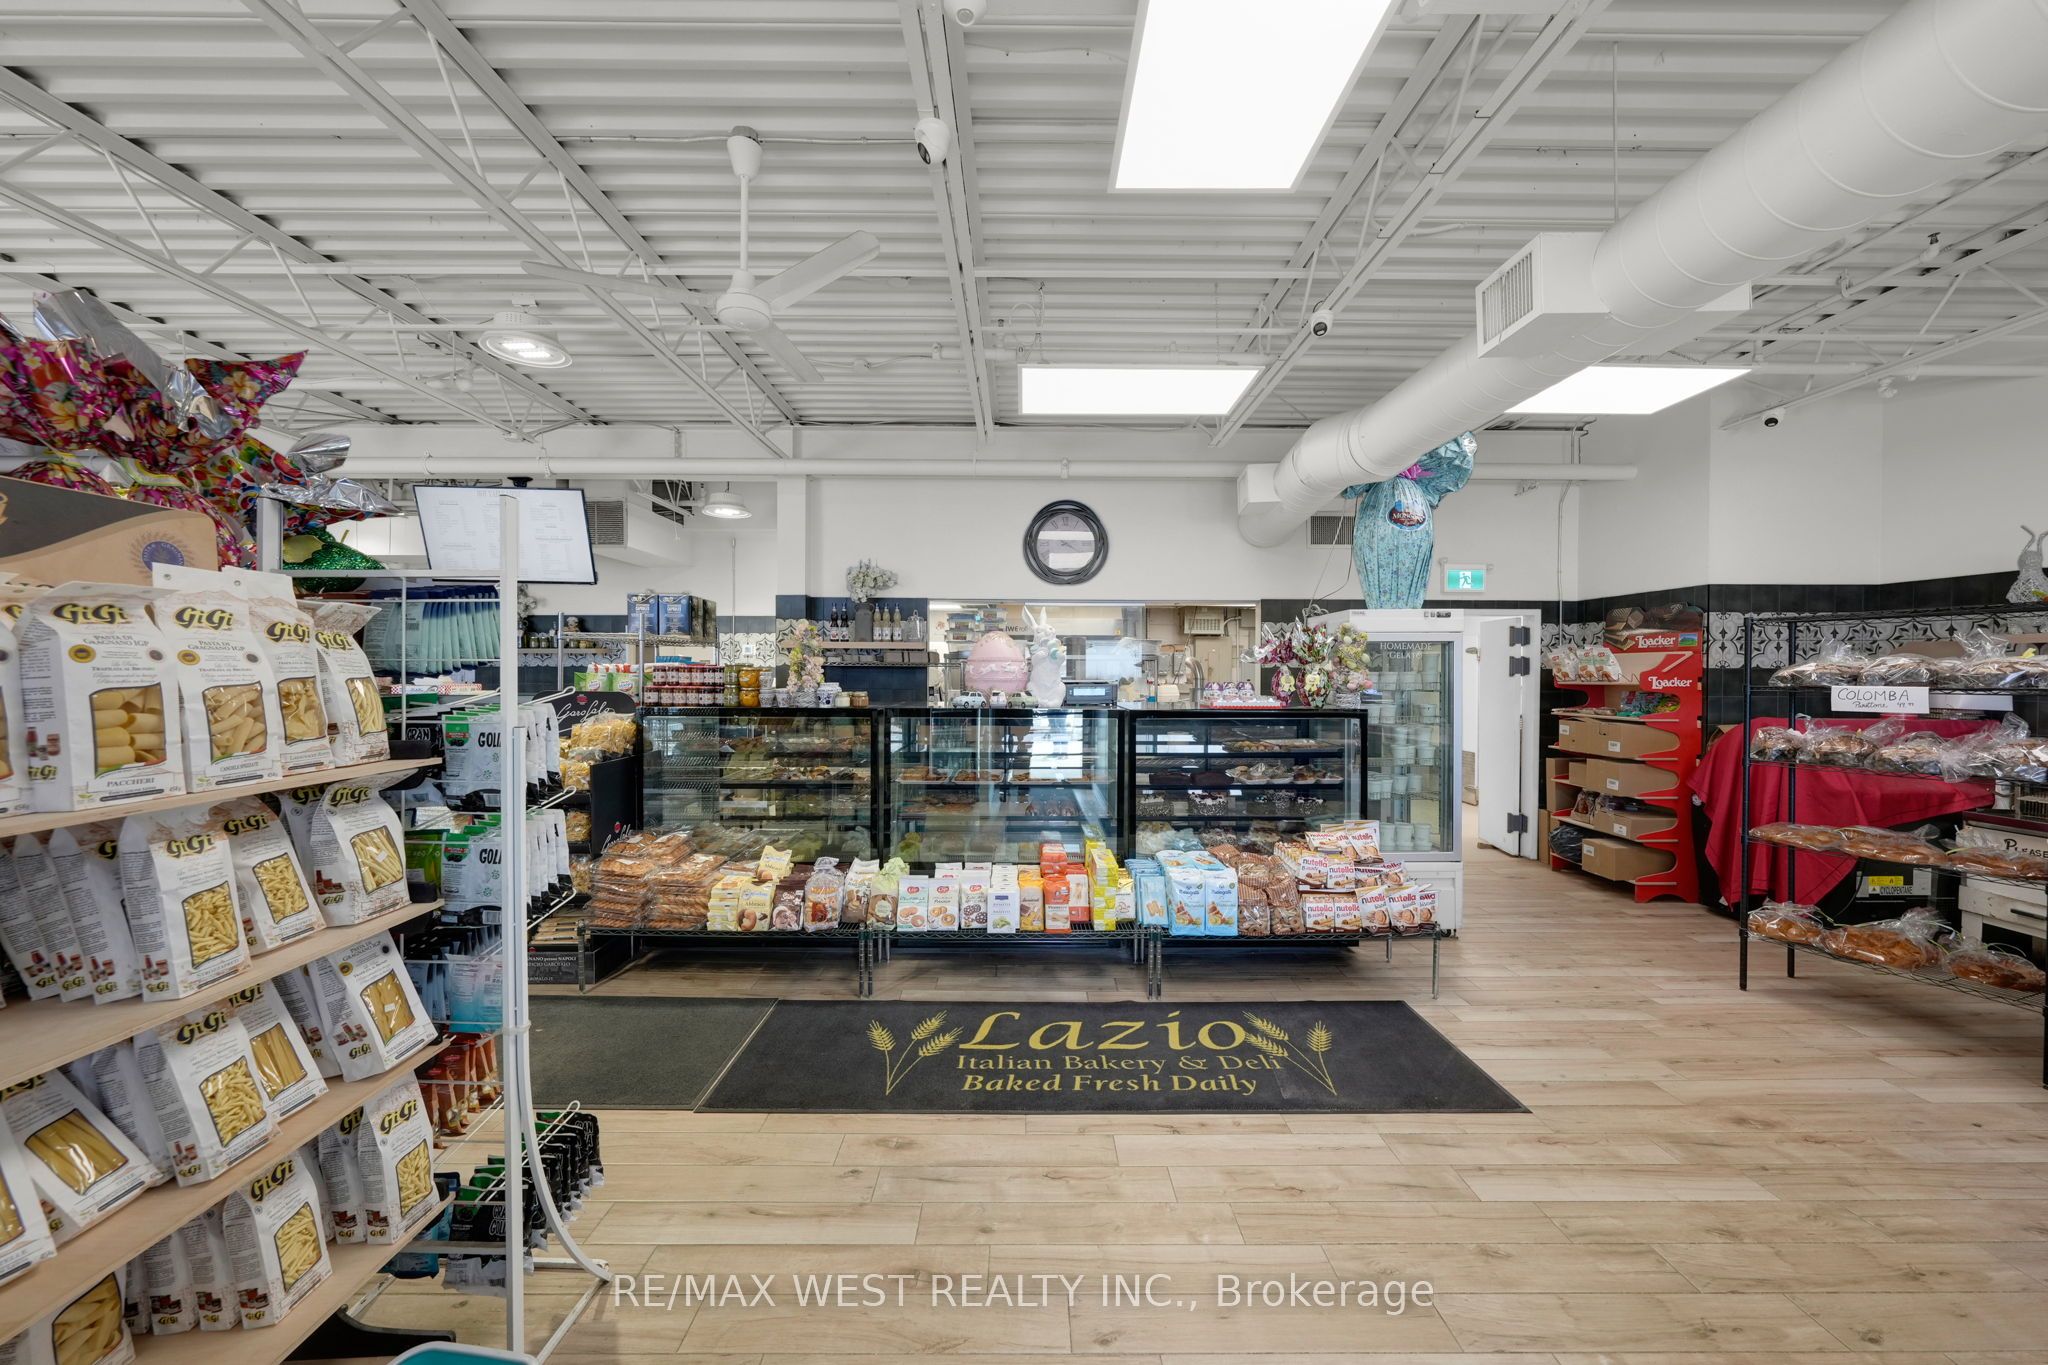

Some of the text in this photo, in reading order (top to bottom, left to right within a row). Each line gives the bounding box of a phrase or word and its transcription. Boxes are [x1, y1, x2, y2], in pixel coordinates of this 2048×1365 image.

[53, 603, 129, 624] GiGi
[175, 606, 233, 630] GiGi
[266, 621, 310, 642] GiGi
[315, 632, 352, 650] GiGi
[1380, 642, 1433, 650] HOMEMADE
[1635, 635, 1676, 649] Loacker
[1389, 651, 1423, 659] GELATO
[1648, 676, 1693, 690] Loacker
[1837, 687, 1909, 701] COLOMBA
[107, 778, 155, 787] PACCHERI
[223, 815, 268, 835] GiGi
[166, 835, 214, 858] GiGi
[1302, 858, 1328, 868] nutella
[1329, 866, 1355, 874] nutella
[1388, 893, 1417, 903] nutella
[1880, 886, 1913, 895] CYCLOPENTANE
[176, 1011, 227, 1045] GiGi
[959, 1010, 1247, 1051] Lazio
[956, 1054, 1282, 1074] Italian Bakery & Deli
[961, 1074, 1257, 1096] Baked Fresh Daily
[251, 1159, 294, 1201] GiGi
